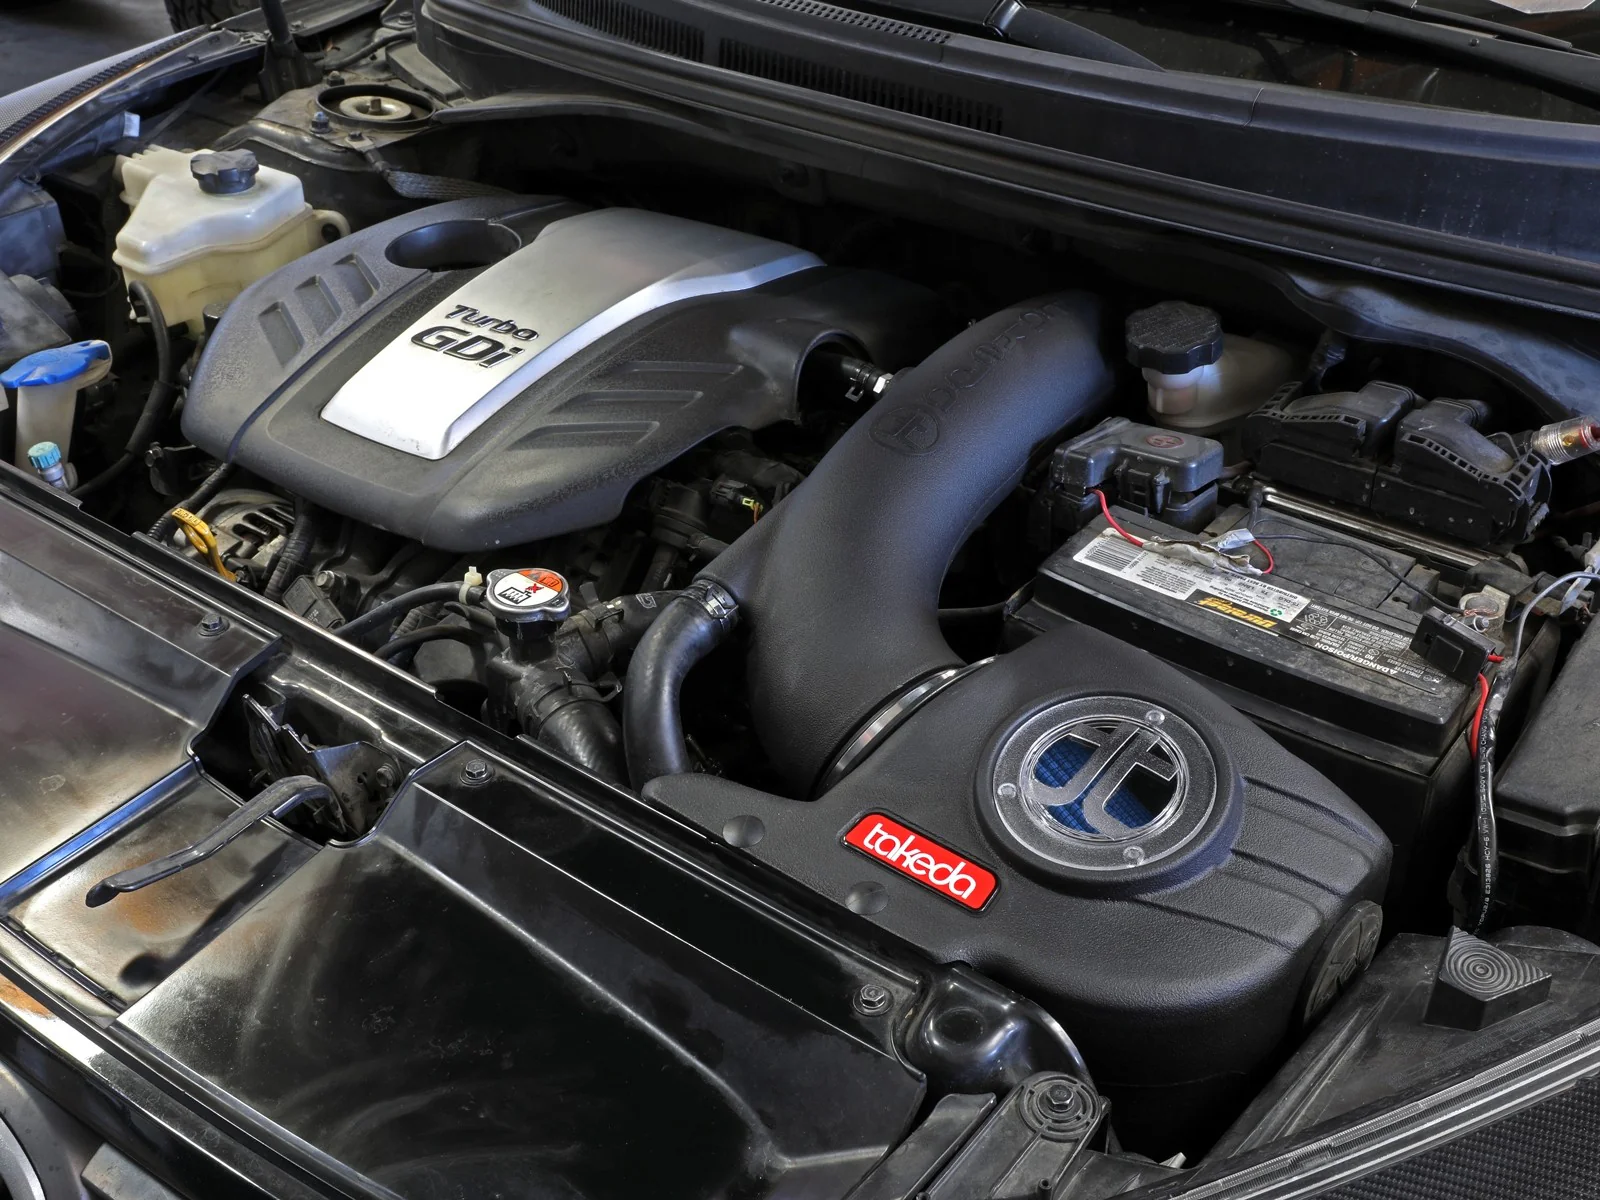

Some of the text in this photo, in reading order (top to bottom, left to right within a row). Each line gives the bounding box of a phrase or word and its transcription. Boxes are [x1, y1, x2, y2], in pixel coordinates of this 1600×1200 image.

[445, 304, 539, 341] Turbo
[410, 325, 525, 368] GDi
[1314, 640, 1389, 674] DANGER/POISON
[863, 823, 977, 899] takeda
